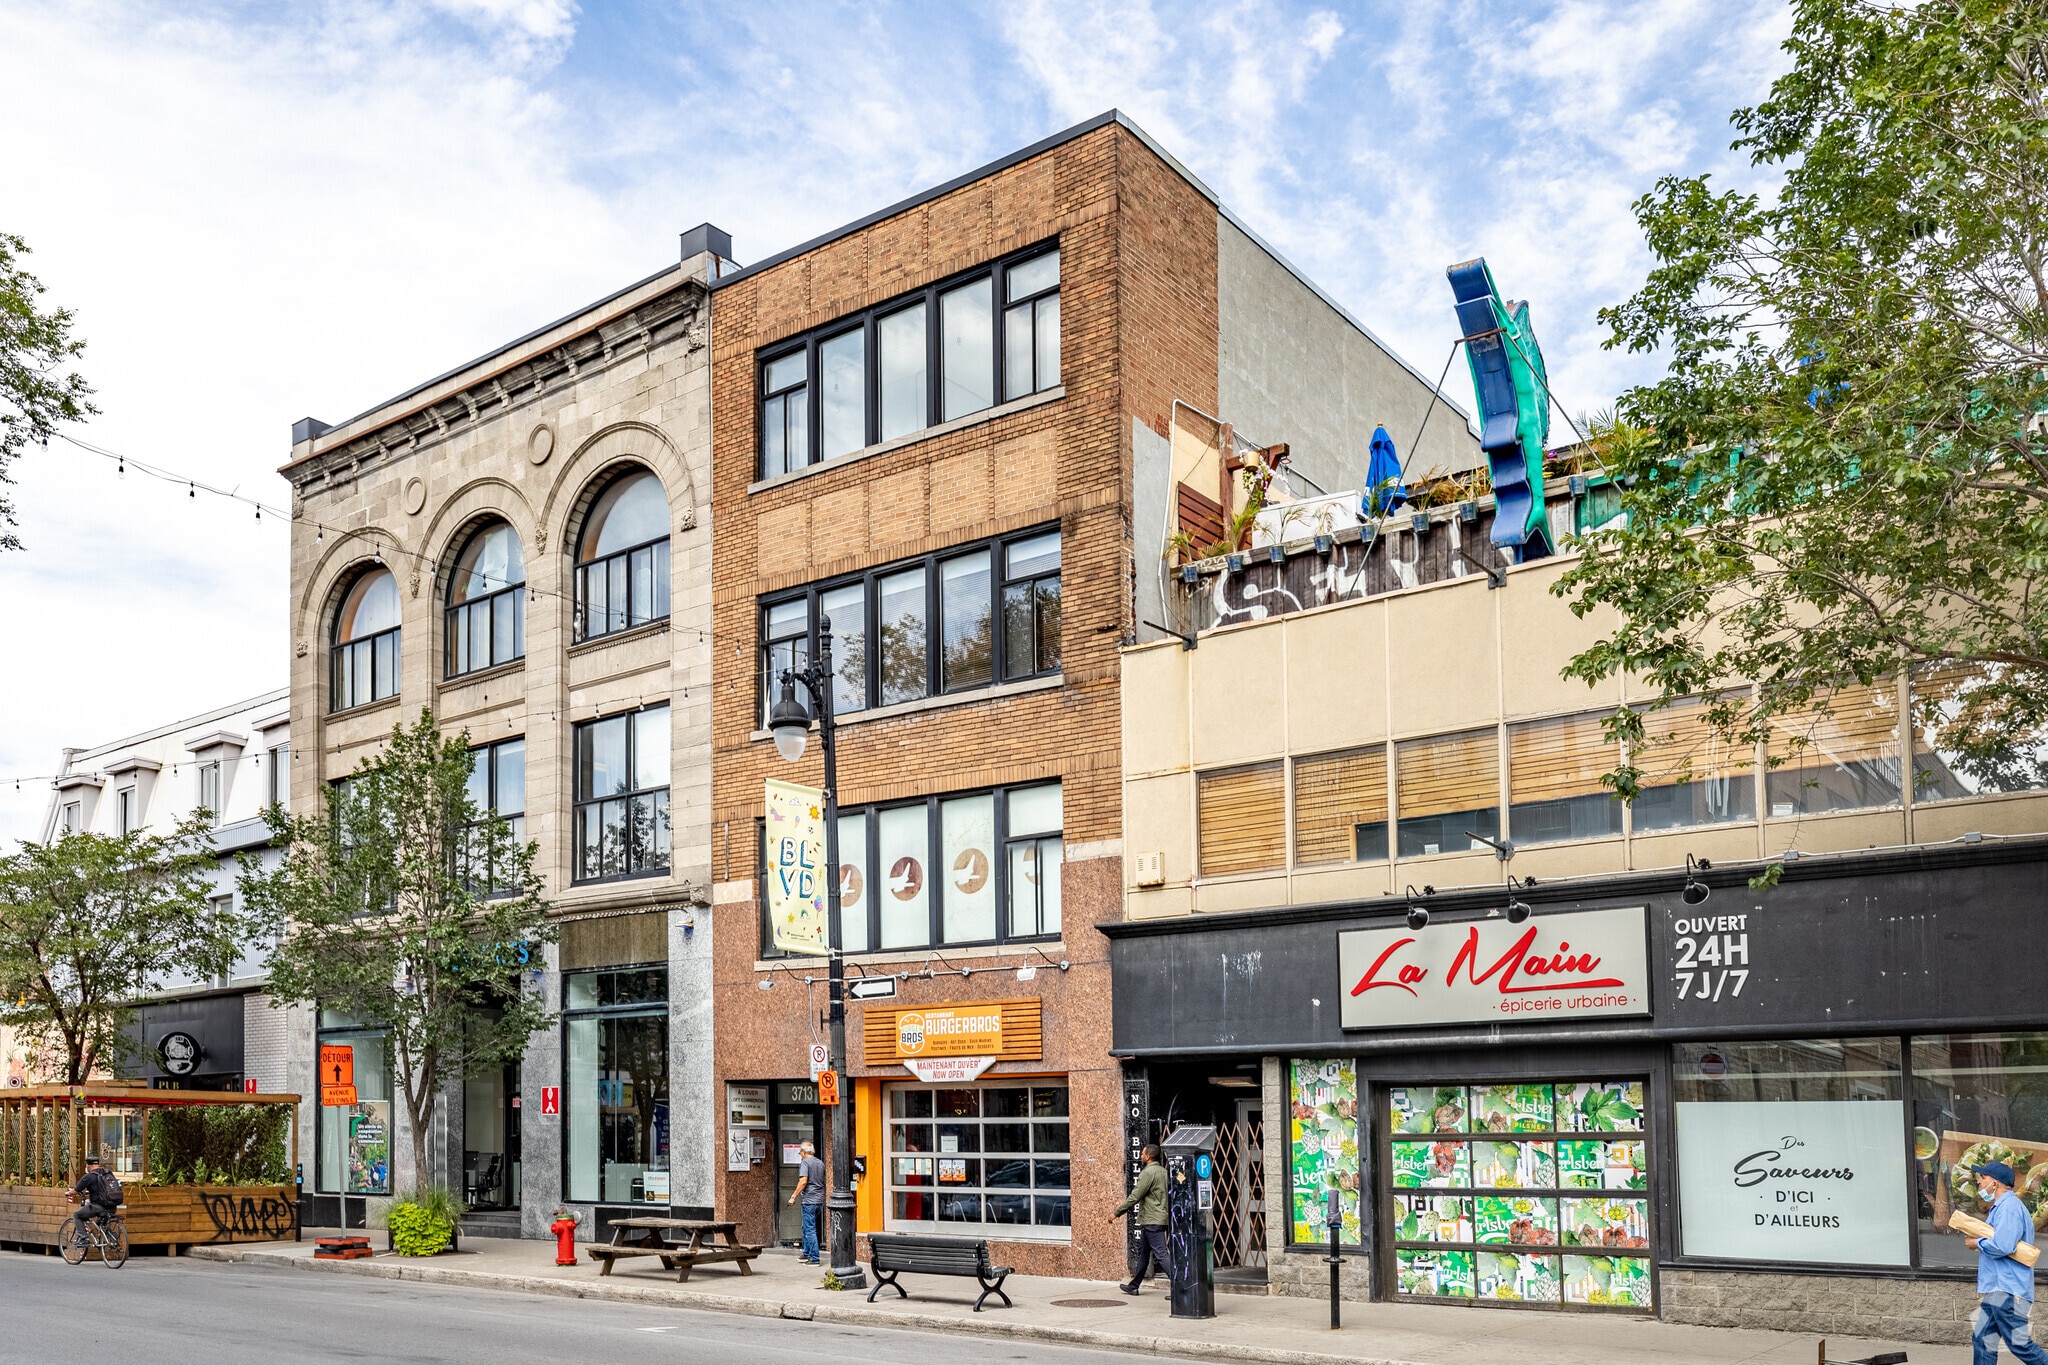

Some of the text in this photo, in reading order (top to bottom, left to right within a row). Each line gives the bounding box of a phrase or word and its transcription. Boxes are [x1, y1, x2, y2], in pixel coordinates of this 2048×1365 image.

[1674, 914, 1748, 934] OUVERT
[1675, 933, 1749, 968] 24H
[1350, 926, 1624, 997] La Main
[1675, 969, 1749, 1002] 7J/7
[1500, 994, 1628, 1014] épicerie urbaine
[926, 1016, 1000, 1035] BURGERBROS
[902, 1032, 922, 1043] BROS
[322, 1051, 351, 1062] DÉTOUR
[917, 1061, 956, 1070] MAINTENANT
[932, 1070, 964, 1079] NOW OPEN
[158, 1080, 180, 1090] PUB
[792, 1086, 813, 1101] 3713
[1131, 1094, 1140, 1118] NO
[1514, 1122, 1546, 1130] PILSNER
[1778, 1135, 1805, 1150] Des
[1734, 1150, 1854, 1188] Saveurs
[1776, 1190, 1814, 1203] D'ICI
[1754, 1214, 1840, 1228] D'AILLEURS
